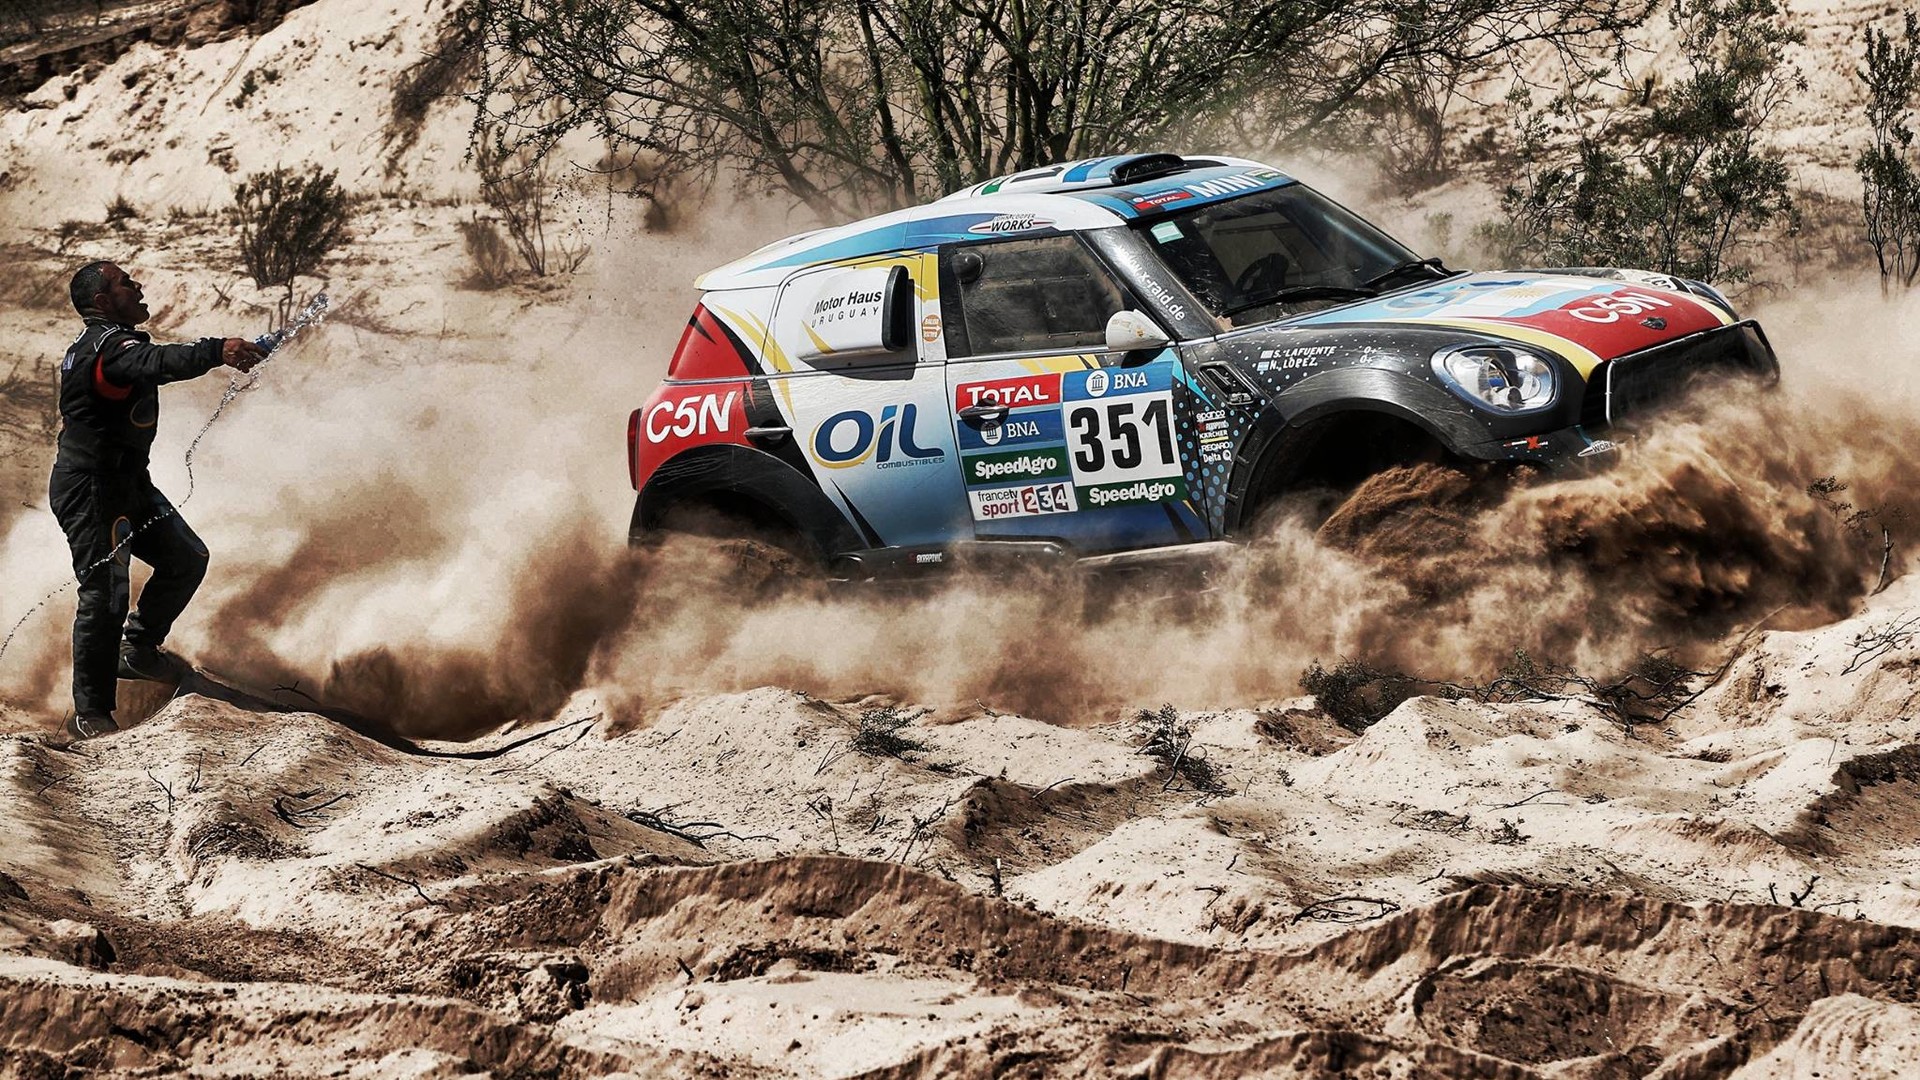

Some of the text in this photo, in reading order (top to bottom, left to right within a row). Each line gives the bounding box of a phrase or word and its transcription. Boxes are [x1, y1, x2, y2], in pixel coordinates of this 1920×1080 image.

[1184, 174, 1266, 198] MINI
[1147, 195, 1181, 206] TOTAL
[991, 219, 1034, 232] WORKS
[813, 291, 882, 315] Motor Haus
[1568, 292, 1673, 324] C5N
[811, 306, 879, 329] URUGUAY
[1284, 346, 1337, 358] LAFUENTE
[1113, 372, 1148, 390] BNA
[966, 384, 1049, 406] TOTAL
[646, 390, 737, 444] C5N
[1006, 421, 1040, 438] BNA
[1070, 399, 1175, 473] 351
[1201, 441, 1230, 452] RECARO
[1203, 449, 1232, 463] Delta Q
[876, 457, 945, 470] COMBUSTIBLES
[975, 456, 1057, 479] SpeedAgro
[978, 489, 1018, 502] francetv
[1089, 481, 1176, 505] SpeedAgro
[982, 499, 1020, 518] sport
